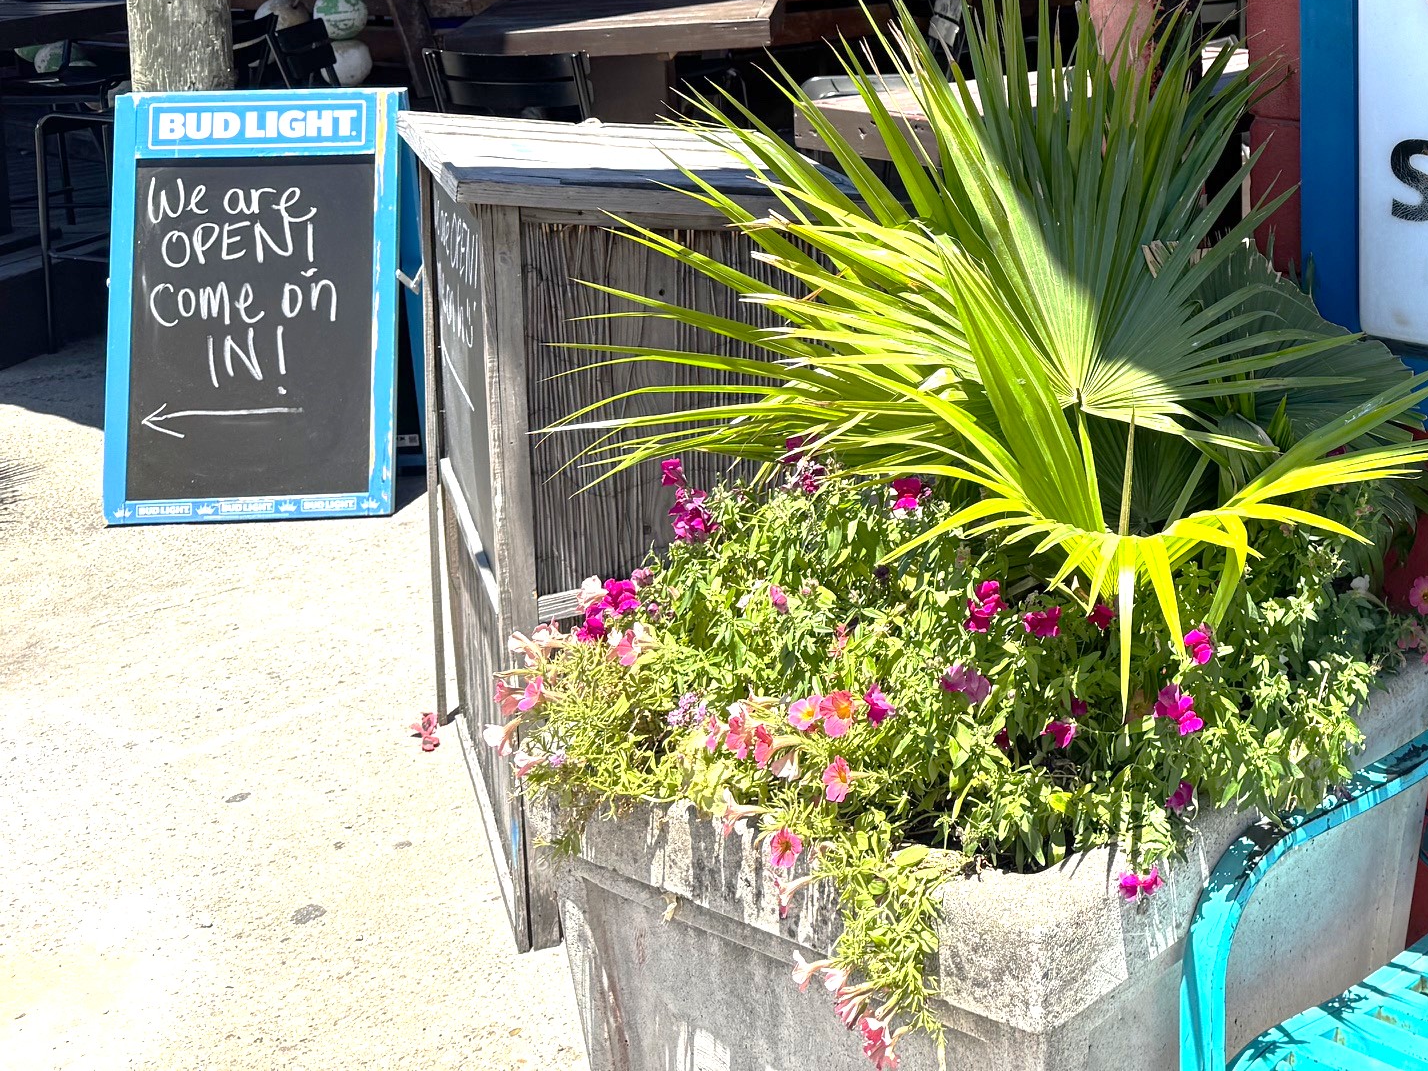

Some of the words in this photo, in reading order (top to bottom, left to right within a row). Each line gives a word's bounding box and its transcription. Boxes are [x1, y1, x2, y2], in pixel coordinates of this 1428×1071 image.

[158, 111, 240, 140] BUD
[147, 176, 209, 224] We
[222, 185, 318, 223] are
[149, 281, 266, 328] come
[280, 277, 338, 322] on
[138, 505, 159, 515] BUD
[161, 504, 190, 515] LIGHT
[221, 503, 242, 512] BUD
[243, 501, 273, 512] LIGHT
[303, 500, 324, 510] BUD
[325, 498, 355, 509] LIGHT
